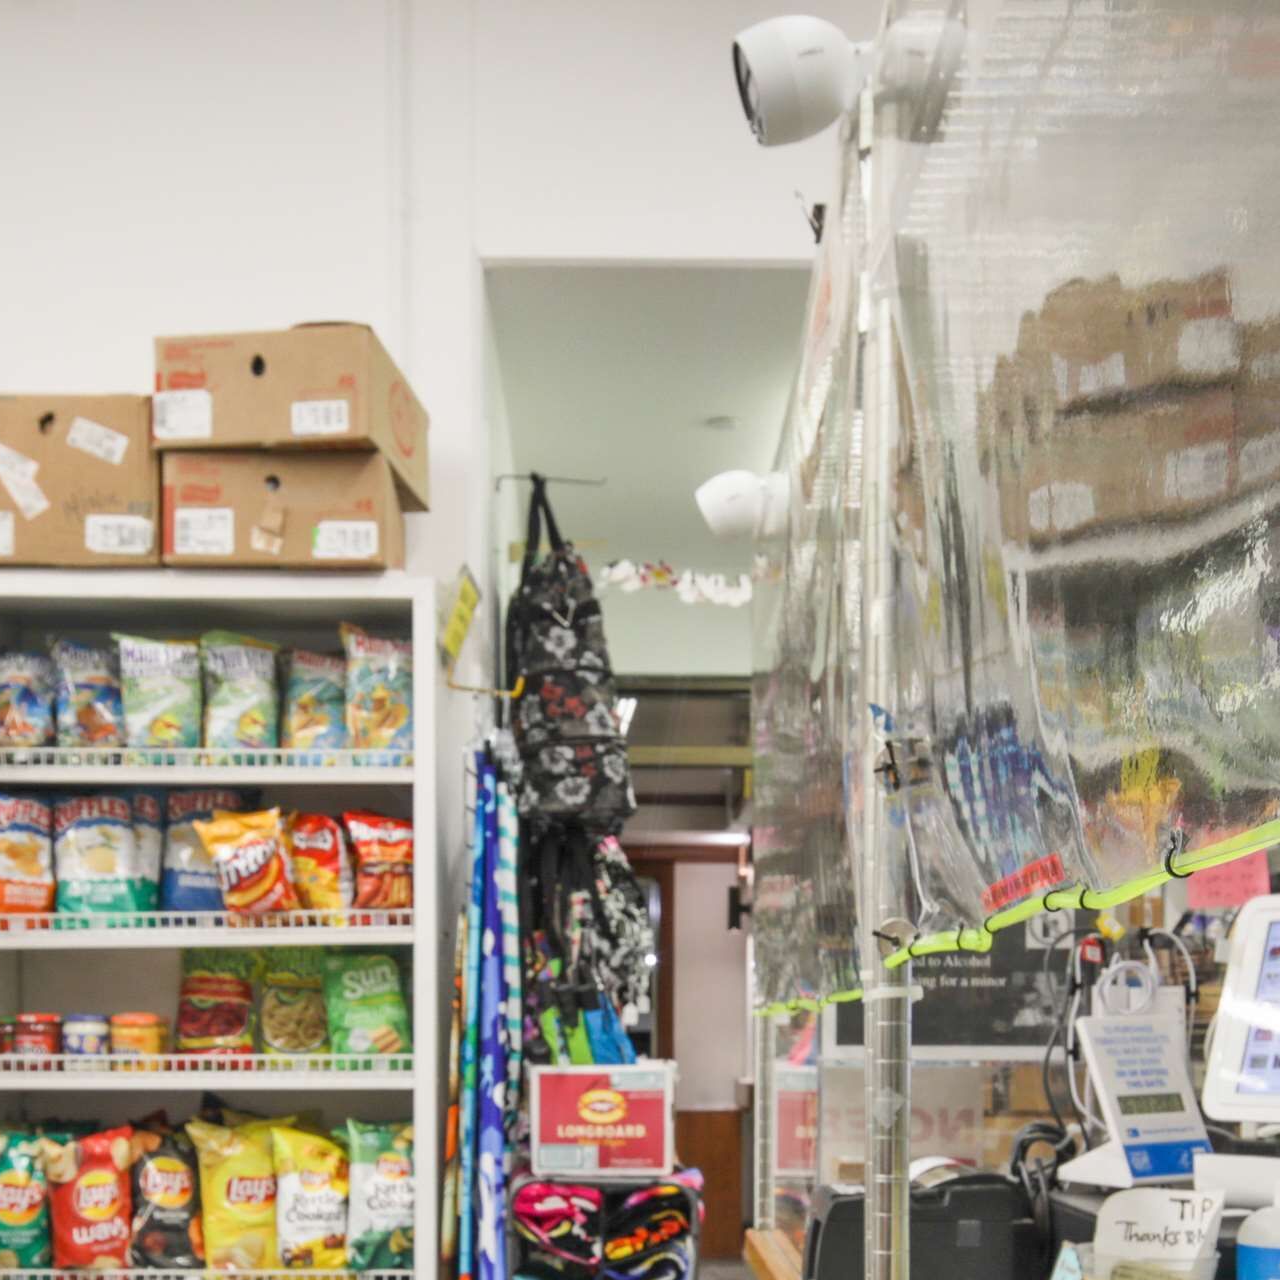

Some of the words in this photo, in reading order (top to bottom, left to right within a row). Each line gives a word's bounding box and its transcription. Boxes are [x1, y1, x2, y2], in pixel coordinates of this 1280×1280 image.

[945, 955, 991, 968] Alcohol
[971, 976, 1007, 987] minor
[556, 1124, 647, 1139] LONGBOARD
[1116, 1222, 1183, 1247] Thanks
